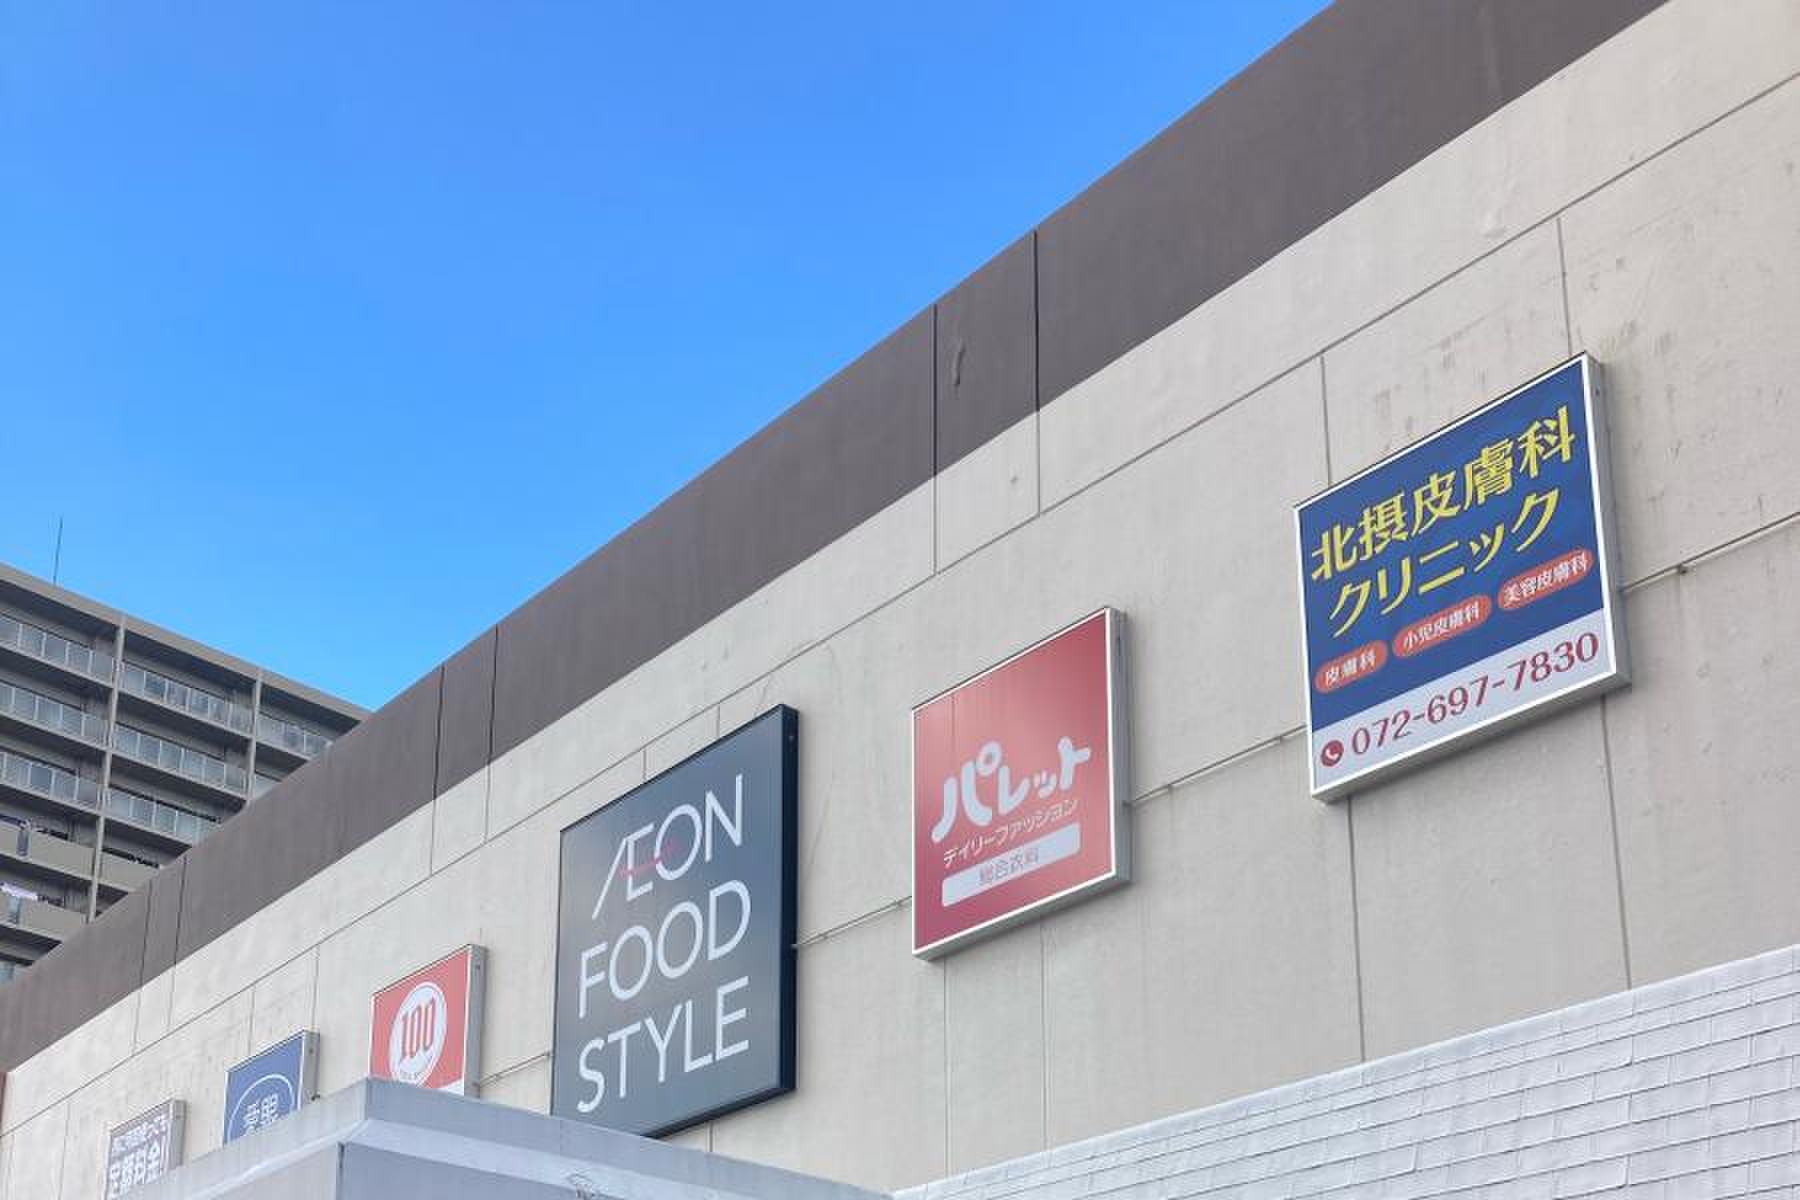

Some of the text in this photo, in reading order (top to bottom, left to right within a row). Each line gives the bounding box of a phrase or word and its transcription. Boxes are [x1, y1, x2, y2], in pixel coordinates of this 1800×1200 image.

[1312, 405, 1576, 582] 北摂皮膚科
[1329, 487, 1561, 638] クリニック
[1503, 552, 1588, 604] 美容皮膚科
[1325, 648, 1377, 687] 皮膚科
[1402, 600, 1481, 651] 小児皮膚科
[1351, 631, 1600, 756] 072-697-7830
[931, 736, 1091, 843] パレット
[579, 880, 752, 1019] FOOD
[401, 996, 437, 1061] 100
[577, 976, 750, 1114] STYLE
